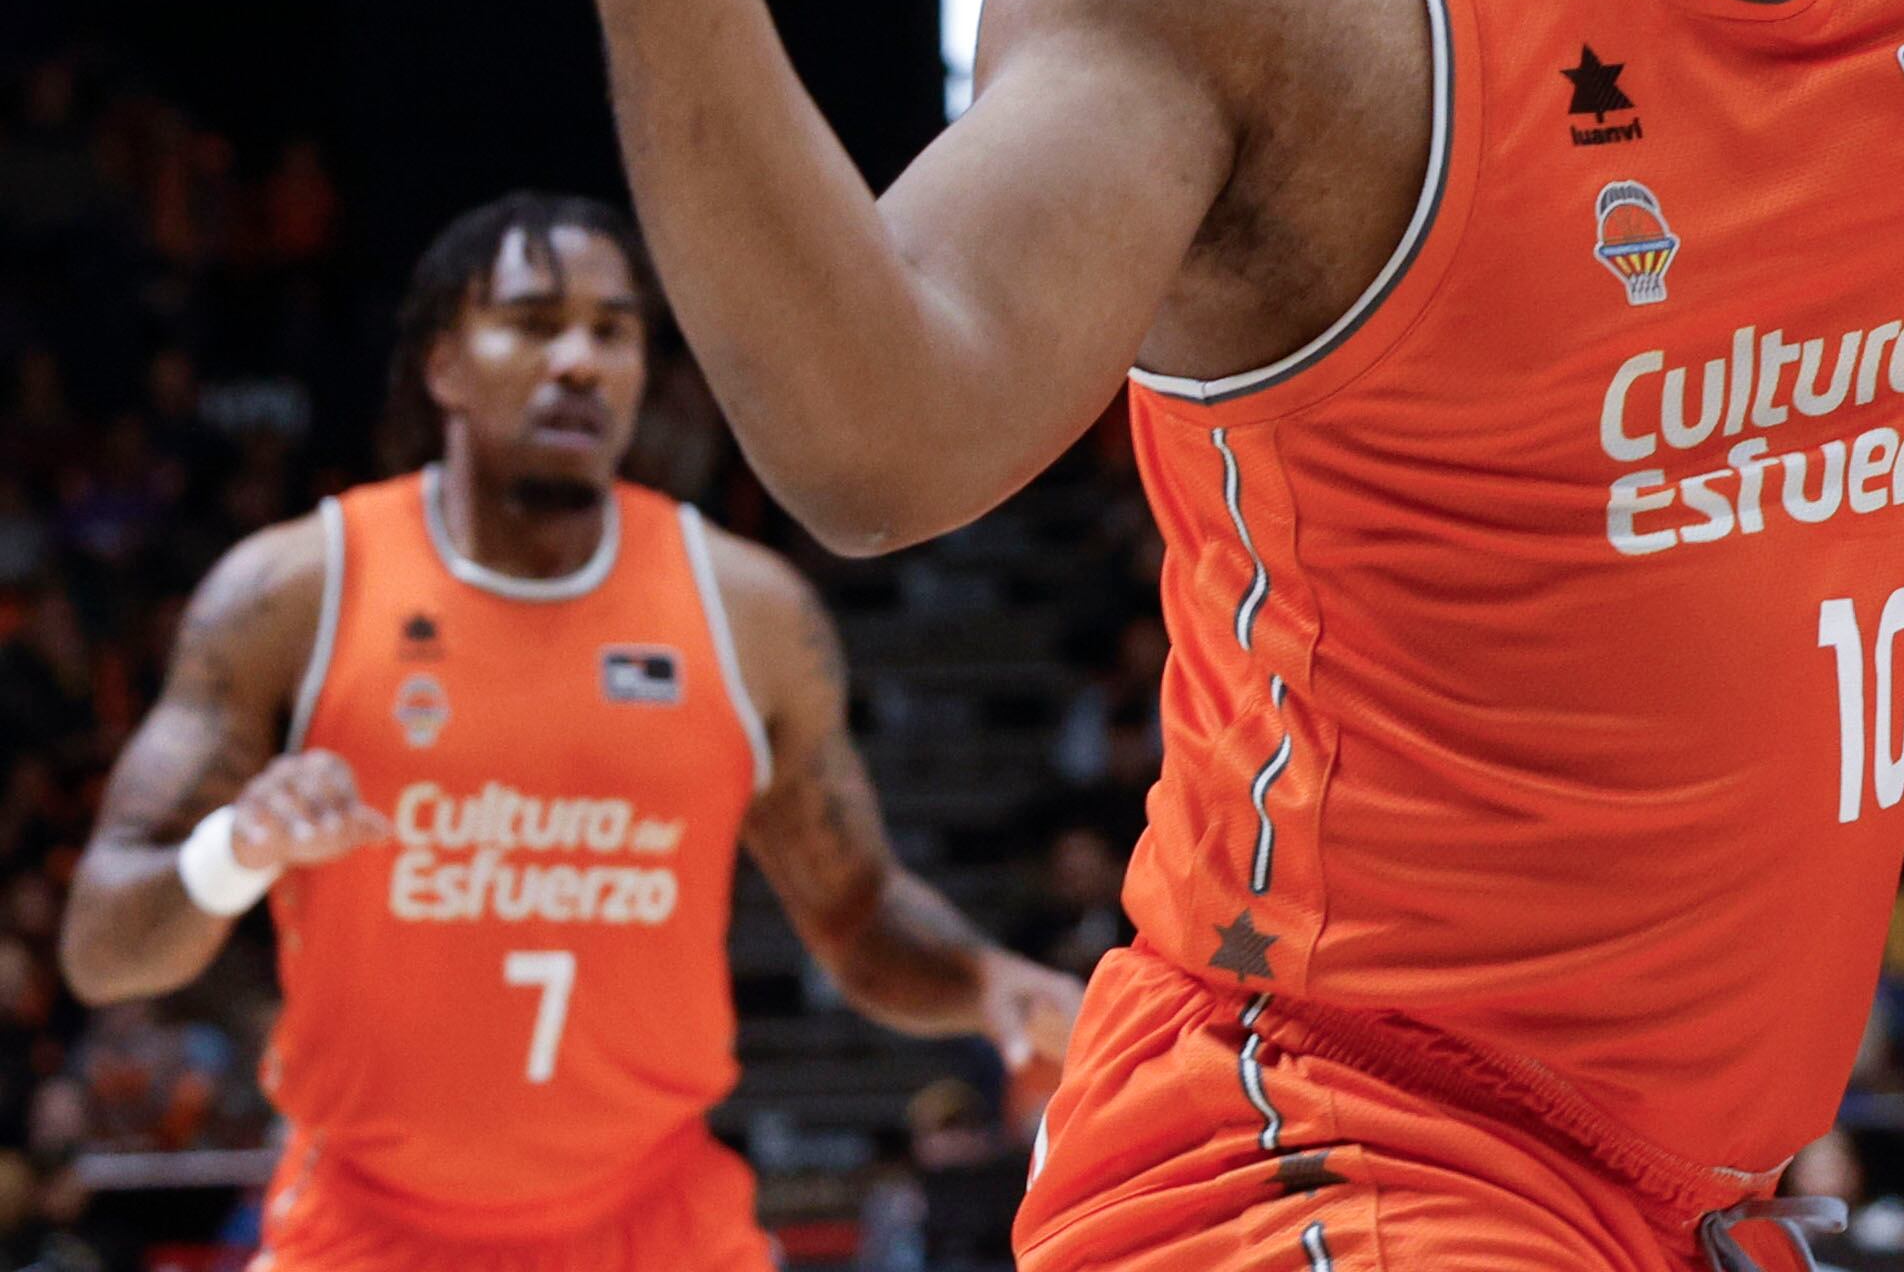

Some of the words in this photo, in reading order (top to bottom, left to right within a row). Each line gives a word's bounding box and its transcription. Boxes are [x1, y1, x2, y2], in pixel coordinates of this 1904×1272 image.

[1568, 116, 1644, 146] luanvi
[396, 781, 634, 853] Cultura
[389, 846, 679, 925] Esfuerzo
[504, 950, 577, 1085] 7
